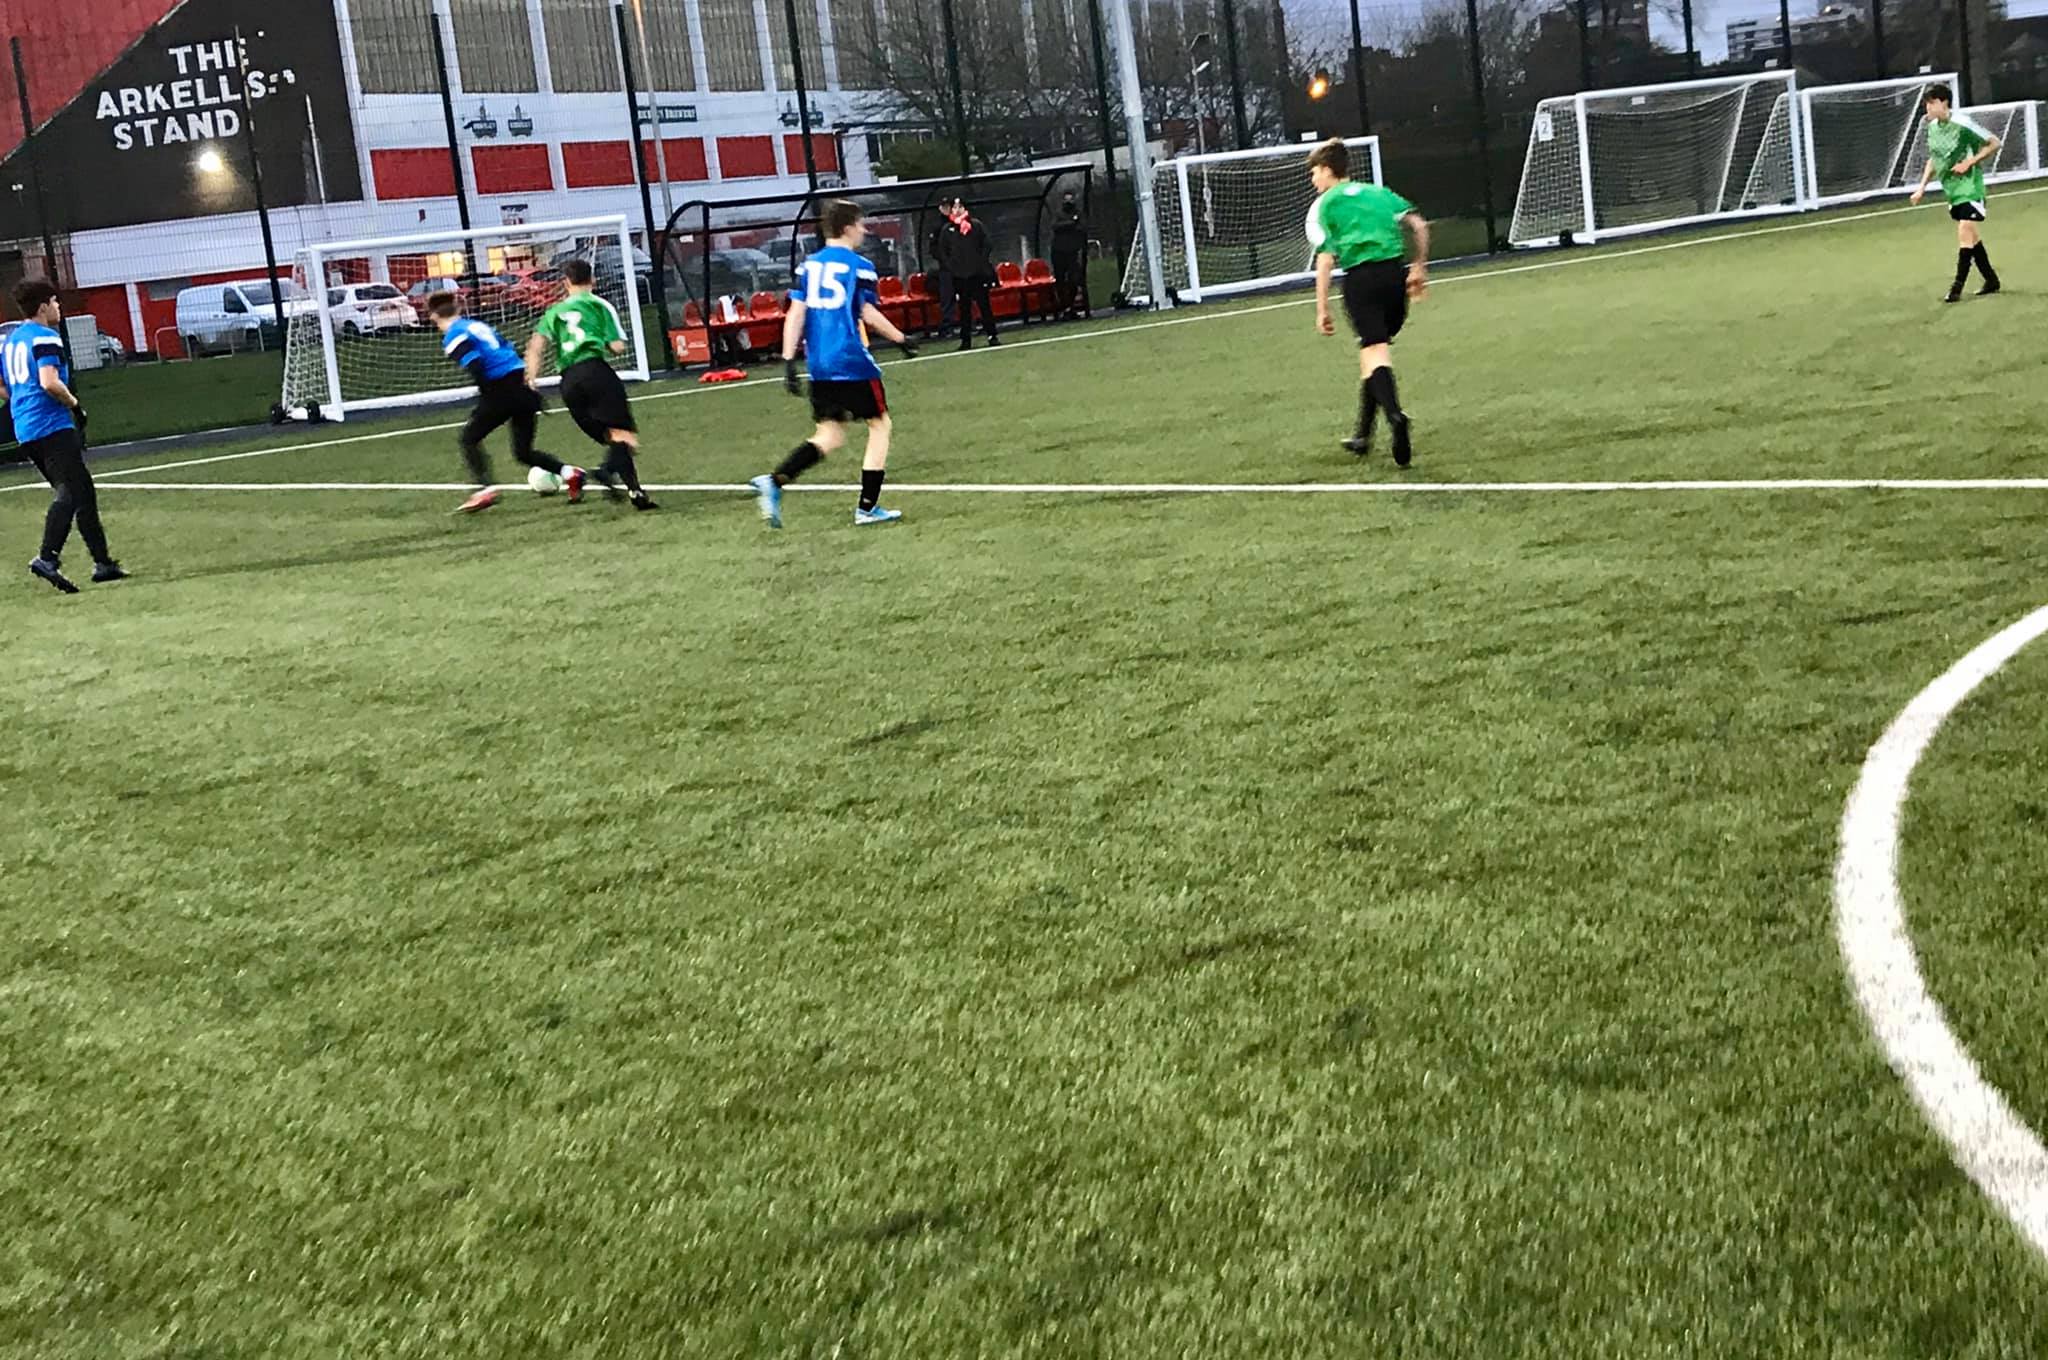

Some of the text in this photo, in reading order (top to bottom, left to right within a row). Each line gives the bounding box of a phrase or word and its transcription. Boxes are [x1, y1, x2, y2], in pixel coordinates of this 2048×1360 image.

[113, 108, 240, 150] STAND
[803, 260, 850, 310] 15
[557, 311, 586, 352] 3
[4, 340, 30, 385] 10
